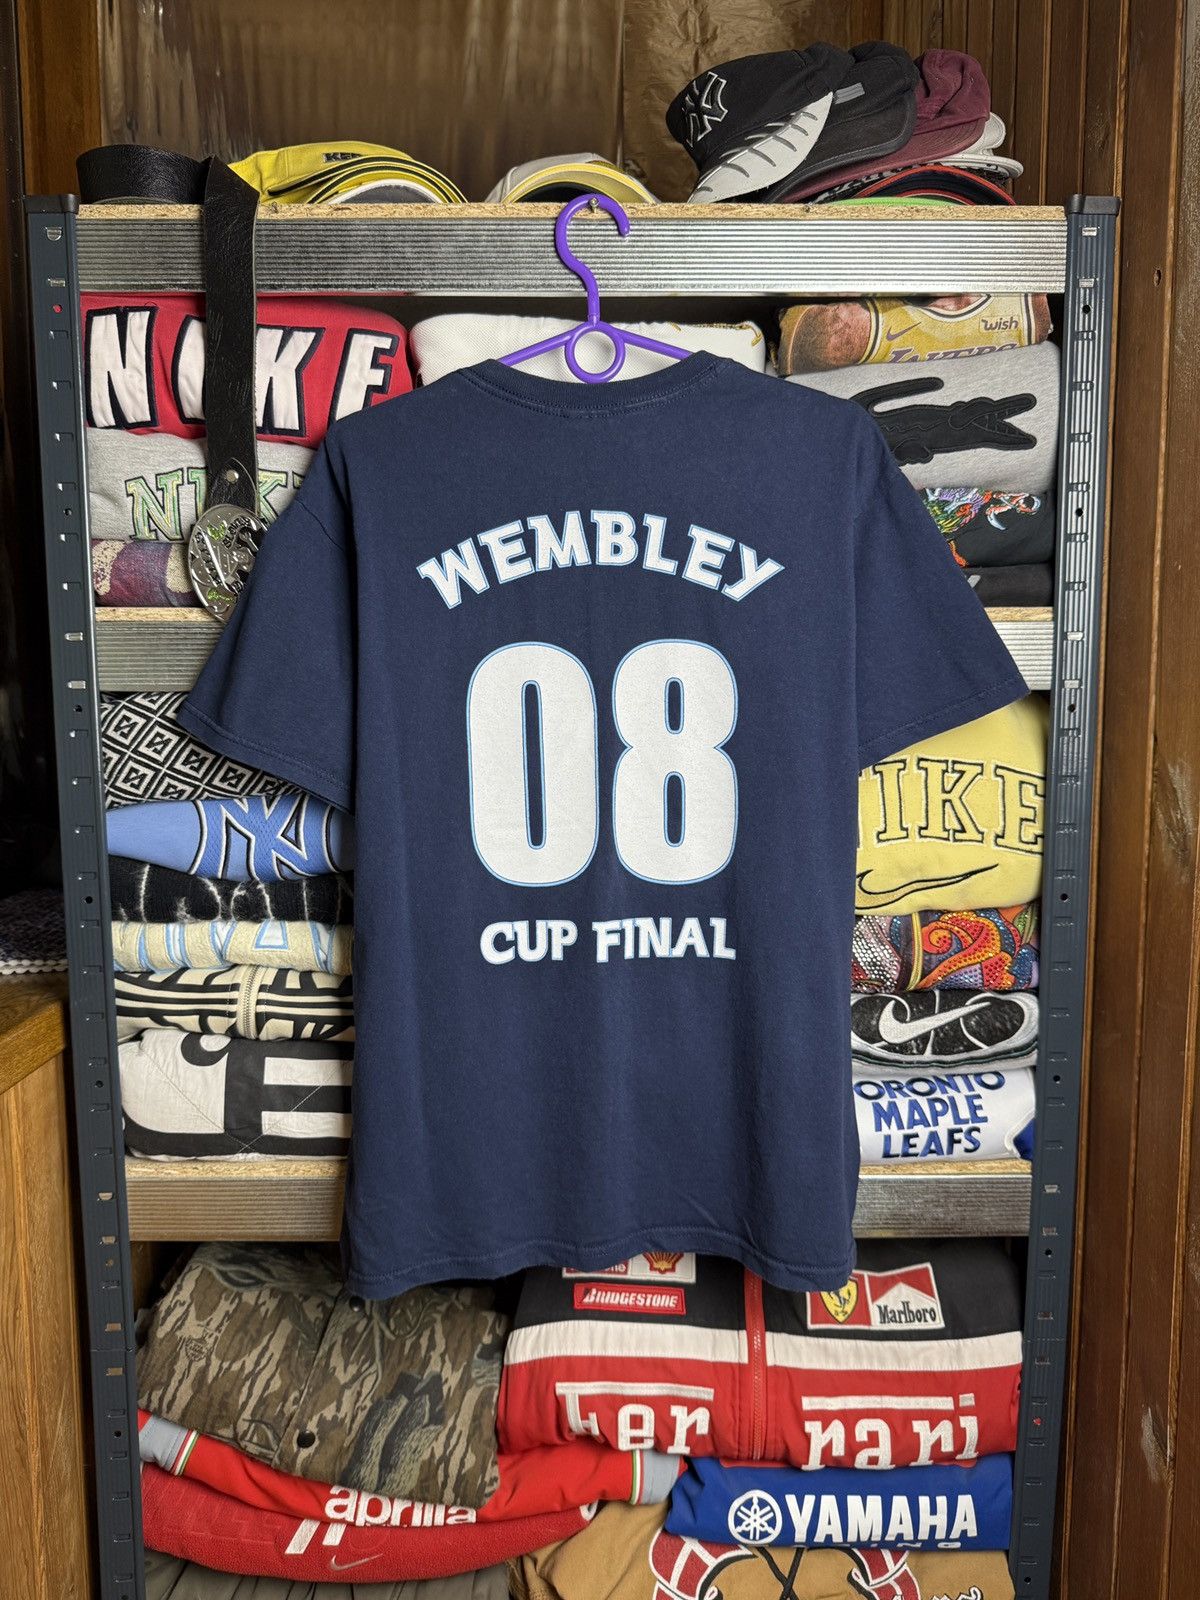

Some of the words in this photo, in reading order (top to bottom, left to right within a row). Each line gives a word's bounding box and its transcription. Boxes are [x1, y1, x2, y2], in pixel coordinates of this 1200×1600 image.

[981, 316, 1019, 332] wish
[416, 510, 785, 610] WEMBLEY
[466, 639, 739, 887] 08
[858, 757, 1045, 856] IKE
[480, 919, 578, 965] CUP
[592, 917, 736, 963] FINAL
[853, 1071, 1006, 1100] ORONTO
[872, 1094, 988, 1133] MAPLE
[882, 1126, 982, 1159] LEAFS
[582, 1287, 679, 1308] BRIDGESTONE
[876, 1301, 937, 1324] Marlboro
[785, 1494, 978, 1544] YAMAHA
